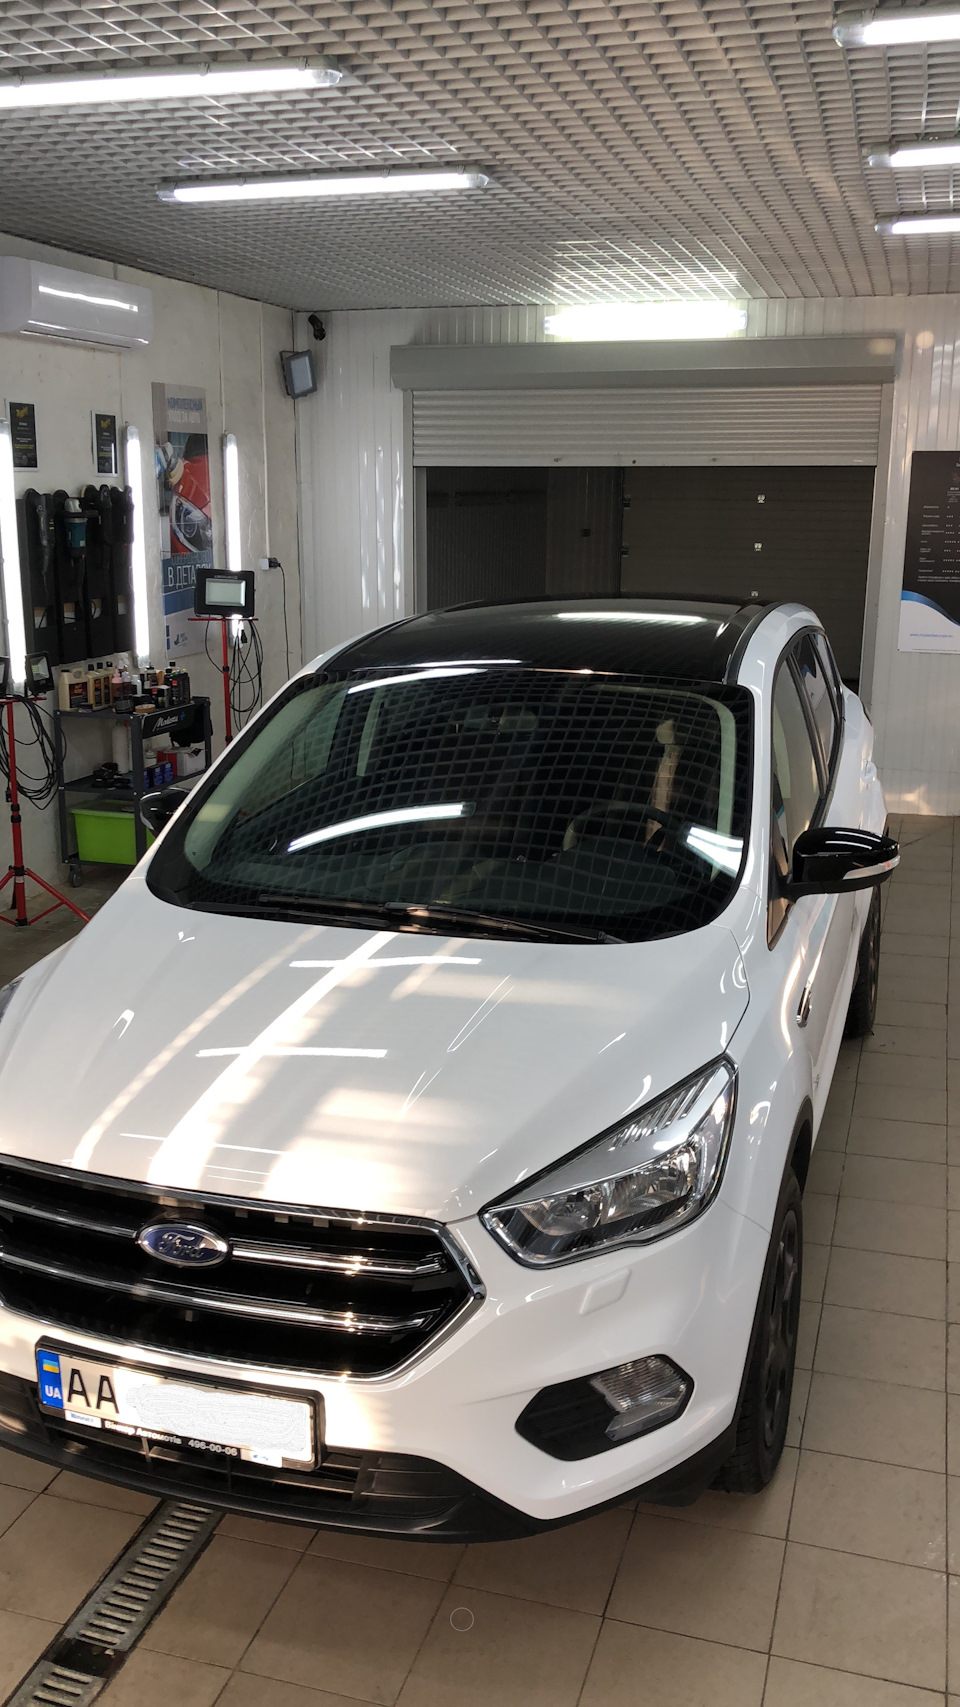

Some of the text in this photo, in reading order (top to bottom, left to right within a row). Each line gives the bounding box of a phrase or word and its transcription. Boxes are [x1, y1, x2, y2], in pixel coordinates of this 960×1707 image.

[167, 566, 175, 587] В
[158, 1232, 205, 1258] Ford
[44, 1385, 62, 1400] UA
[67, 1368, 120, 1414] AA
